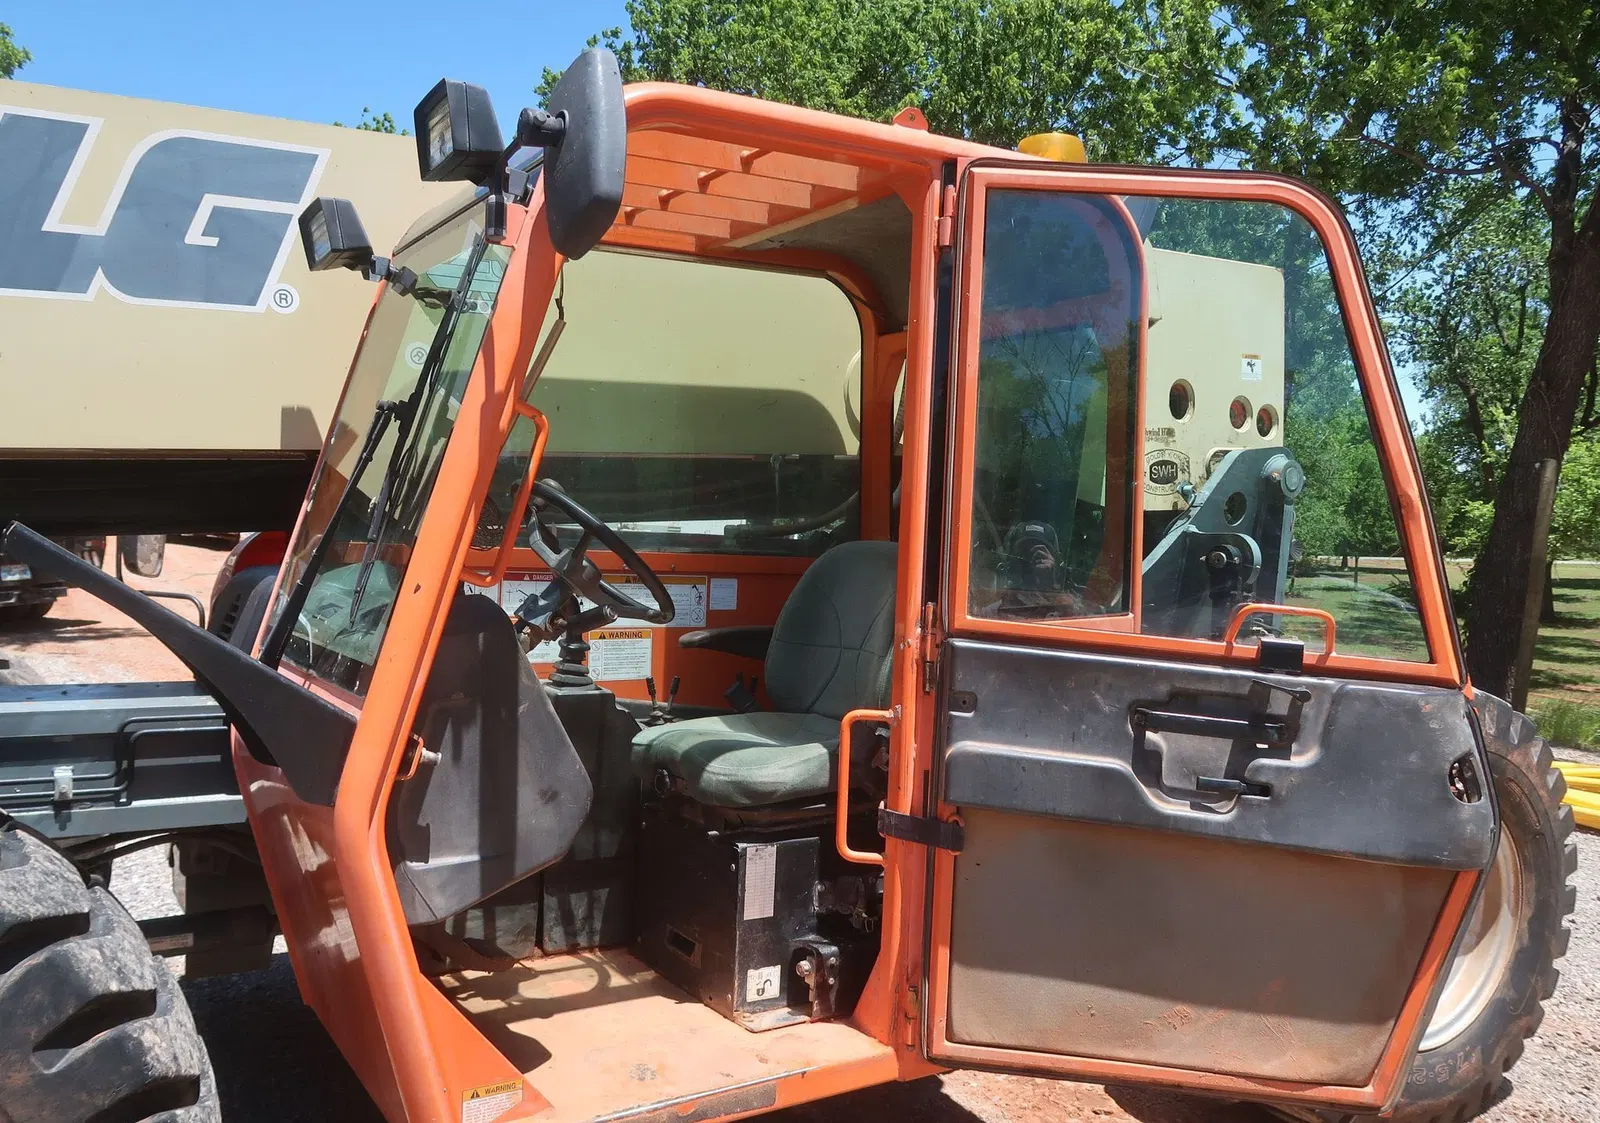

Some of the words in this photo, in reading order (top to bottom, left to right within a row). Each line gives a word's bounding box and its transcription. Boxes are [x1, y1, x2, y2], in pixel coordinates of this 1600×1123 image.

[0, 105, 331, 313] LG
[1151, 464, 1177, 479] SWH
[608, 631, 643, 639] WARNING
[485, 1082, 516, 1094] WARNING
